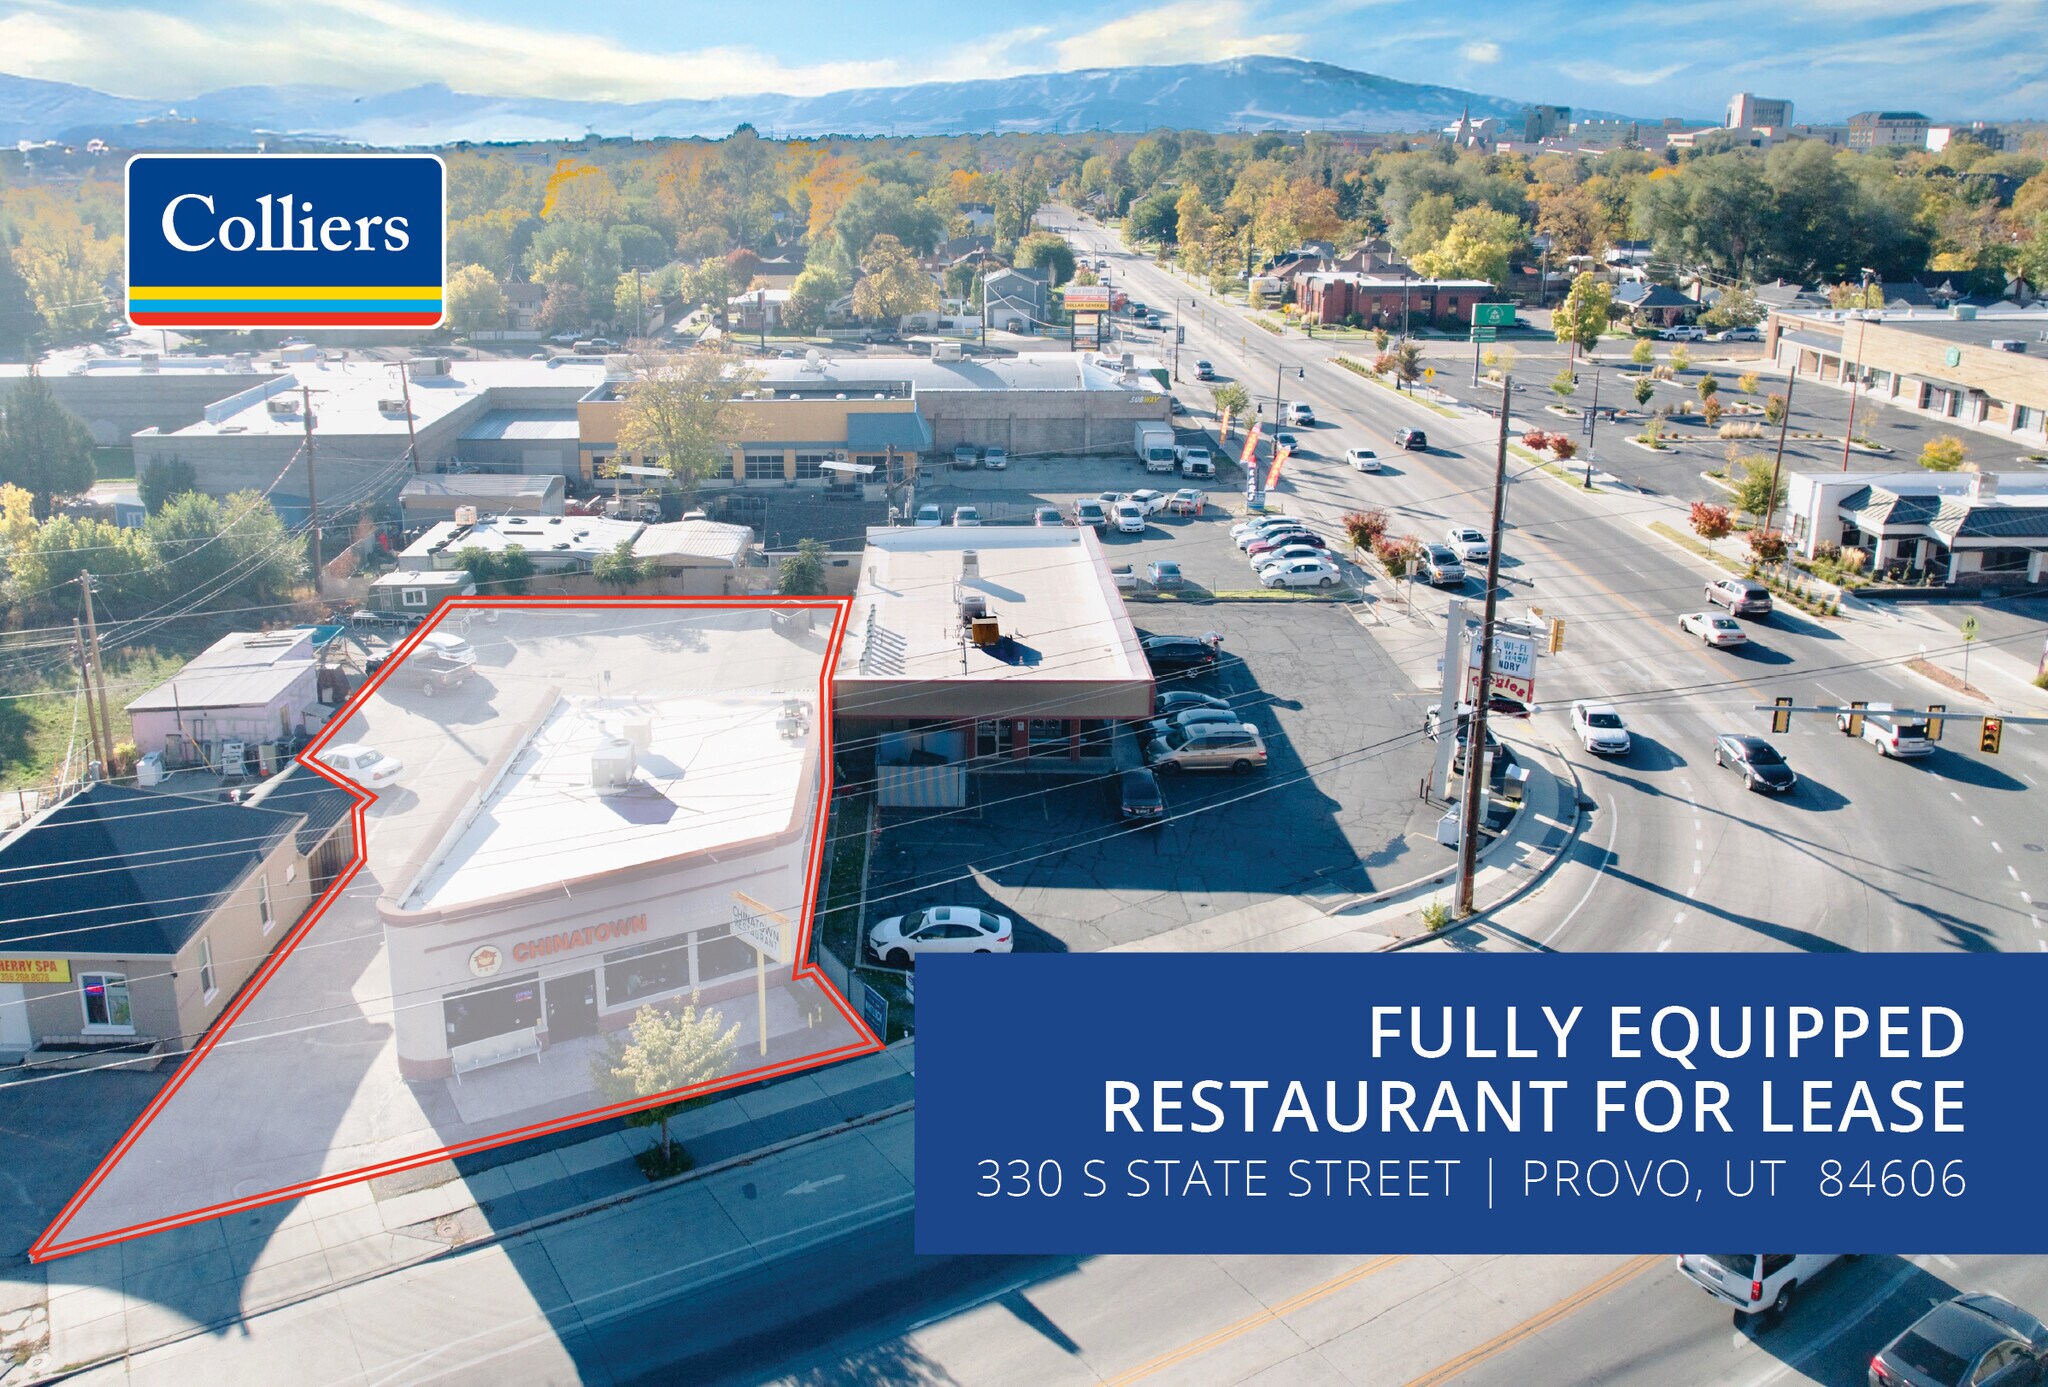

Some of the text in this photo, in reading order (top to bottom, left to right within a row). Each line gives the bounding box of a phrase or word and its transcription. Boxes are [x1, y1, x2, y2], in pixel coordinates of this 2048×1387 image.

[1129, 396, 1160, 404] SUBWAY
[1503, 641, 1527, 653] WI-FI
[732, 905, 780, 942] CHINATOWN
[512, 912, 647, 963] CHINATOWN
[35, 960, 58, 972] SPA
